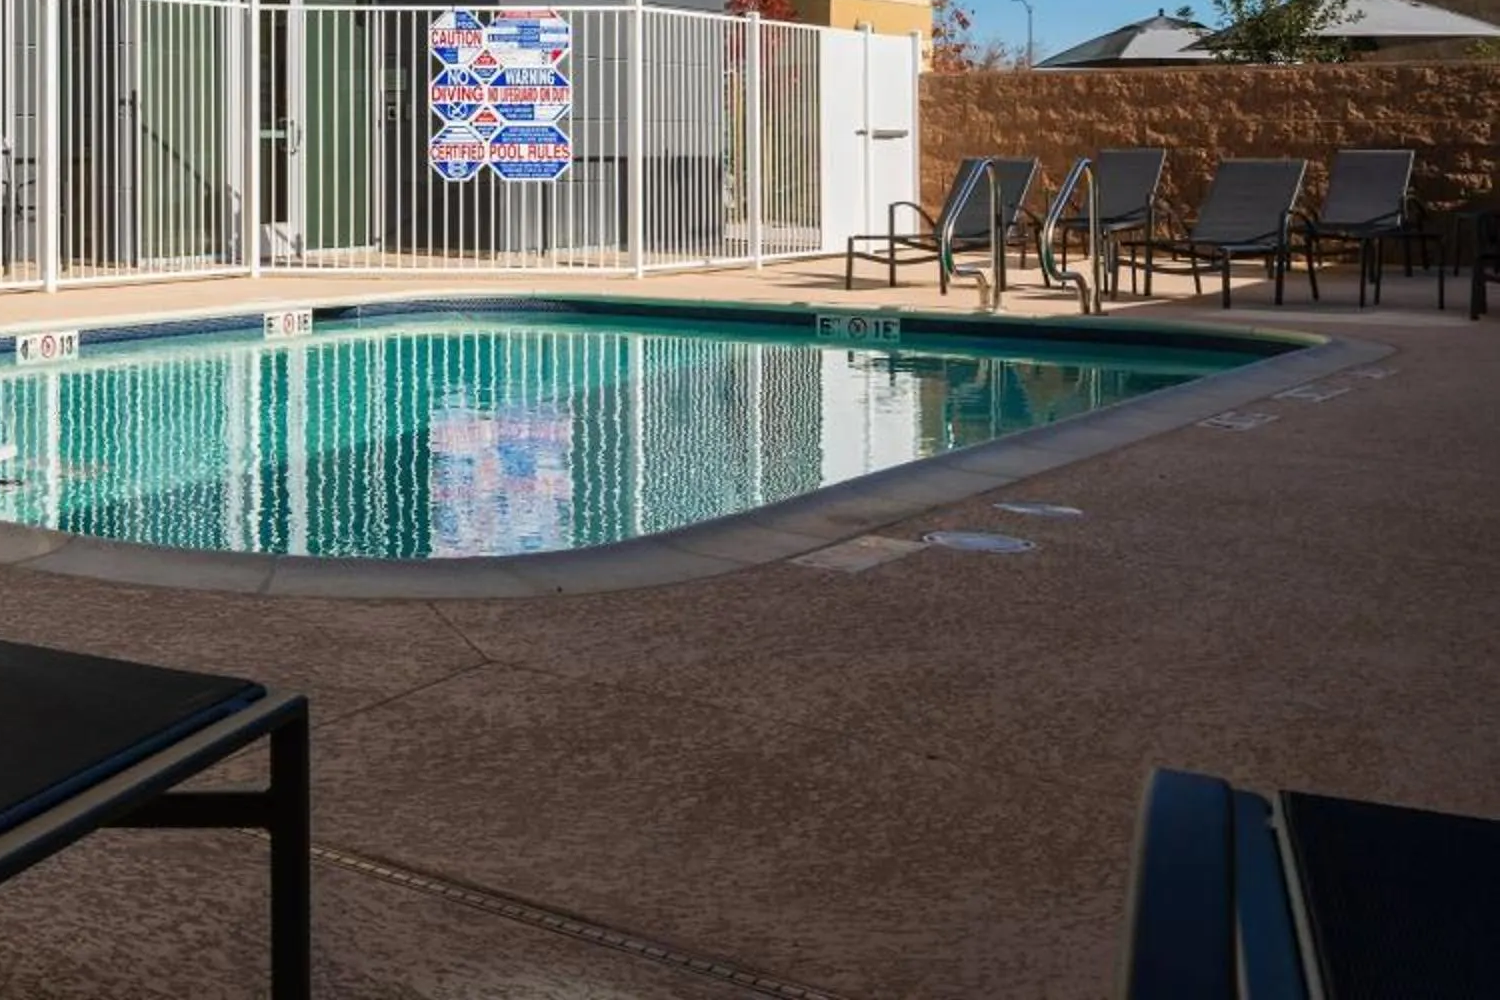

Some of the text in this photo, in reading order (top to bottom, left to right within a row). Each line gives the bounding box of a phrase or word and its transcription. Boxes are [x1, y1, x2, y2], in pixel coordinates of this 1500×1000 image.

[431, 29, 482, 46] CAUTION
[447, 69, 469, 85] NO
[505, 68, 556, 85] WARNING
[431, 87, 485, 102] DIVING
[431, 145, 485, 160] CERTIFIED
[490, 145, 571, 159] POOL RULES
